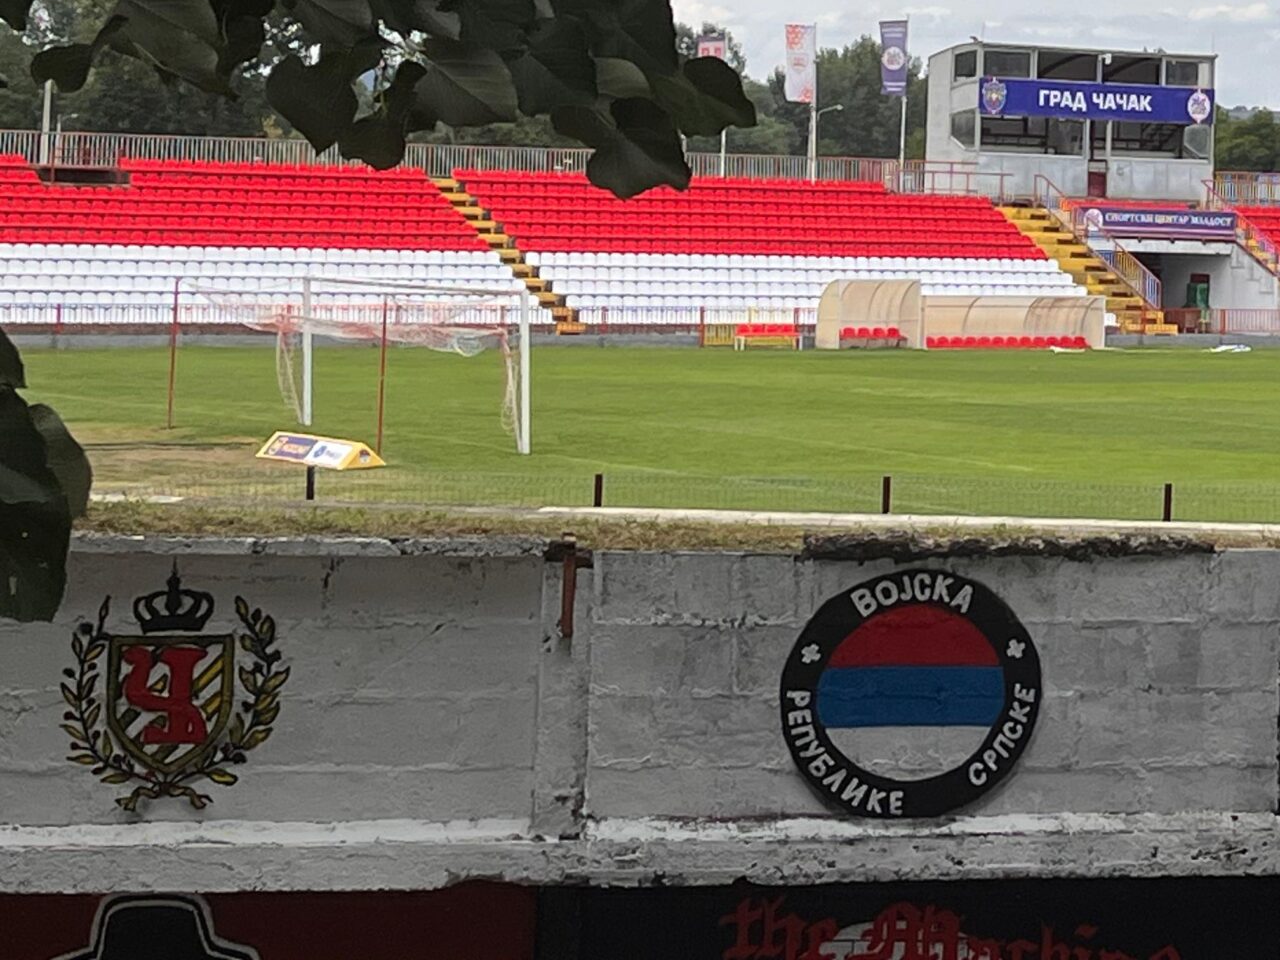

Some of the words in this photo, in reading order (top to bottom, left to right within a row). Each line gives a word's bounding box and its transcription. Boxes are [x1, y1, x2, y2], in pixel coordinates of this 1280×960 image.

[1039, 89, 1087, 112] ГРАД
[1092, 92, 1152, 112] ЧАЧАК
[787, 690, 904, 815] РЕПУБЛИКЕ
[968, 683, 1036, 787] СРПСКЕ
